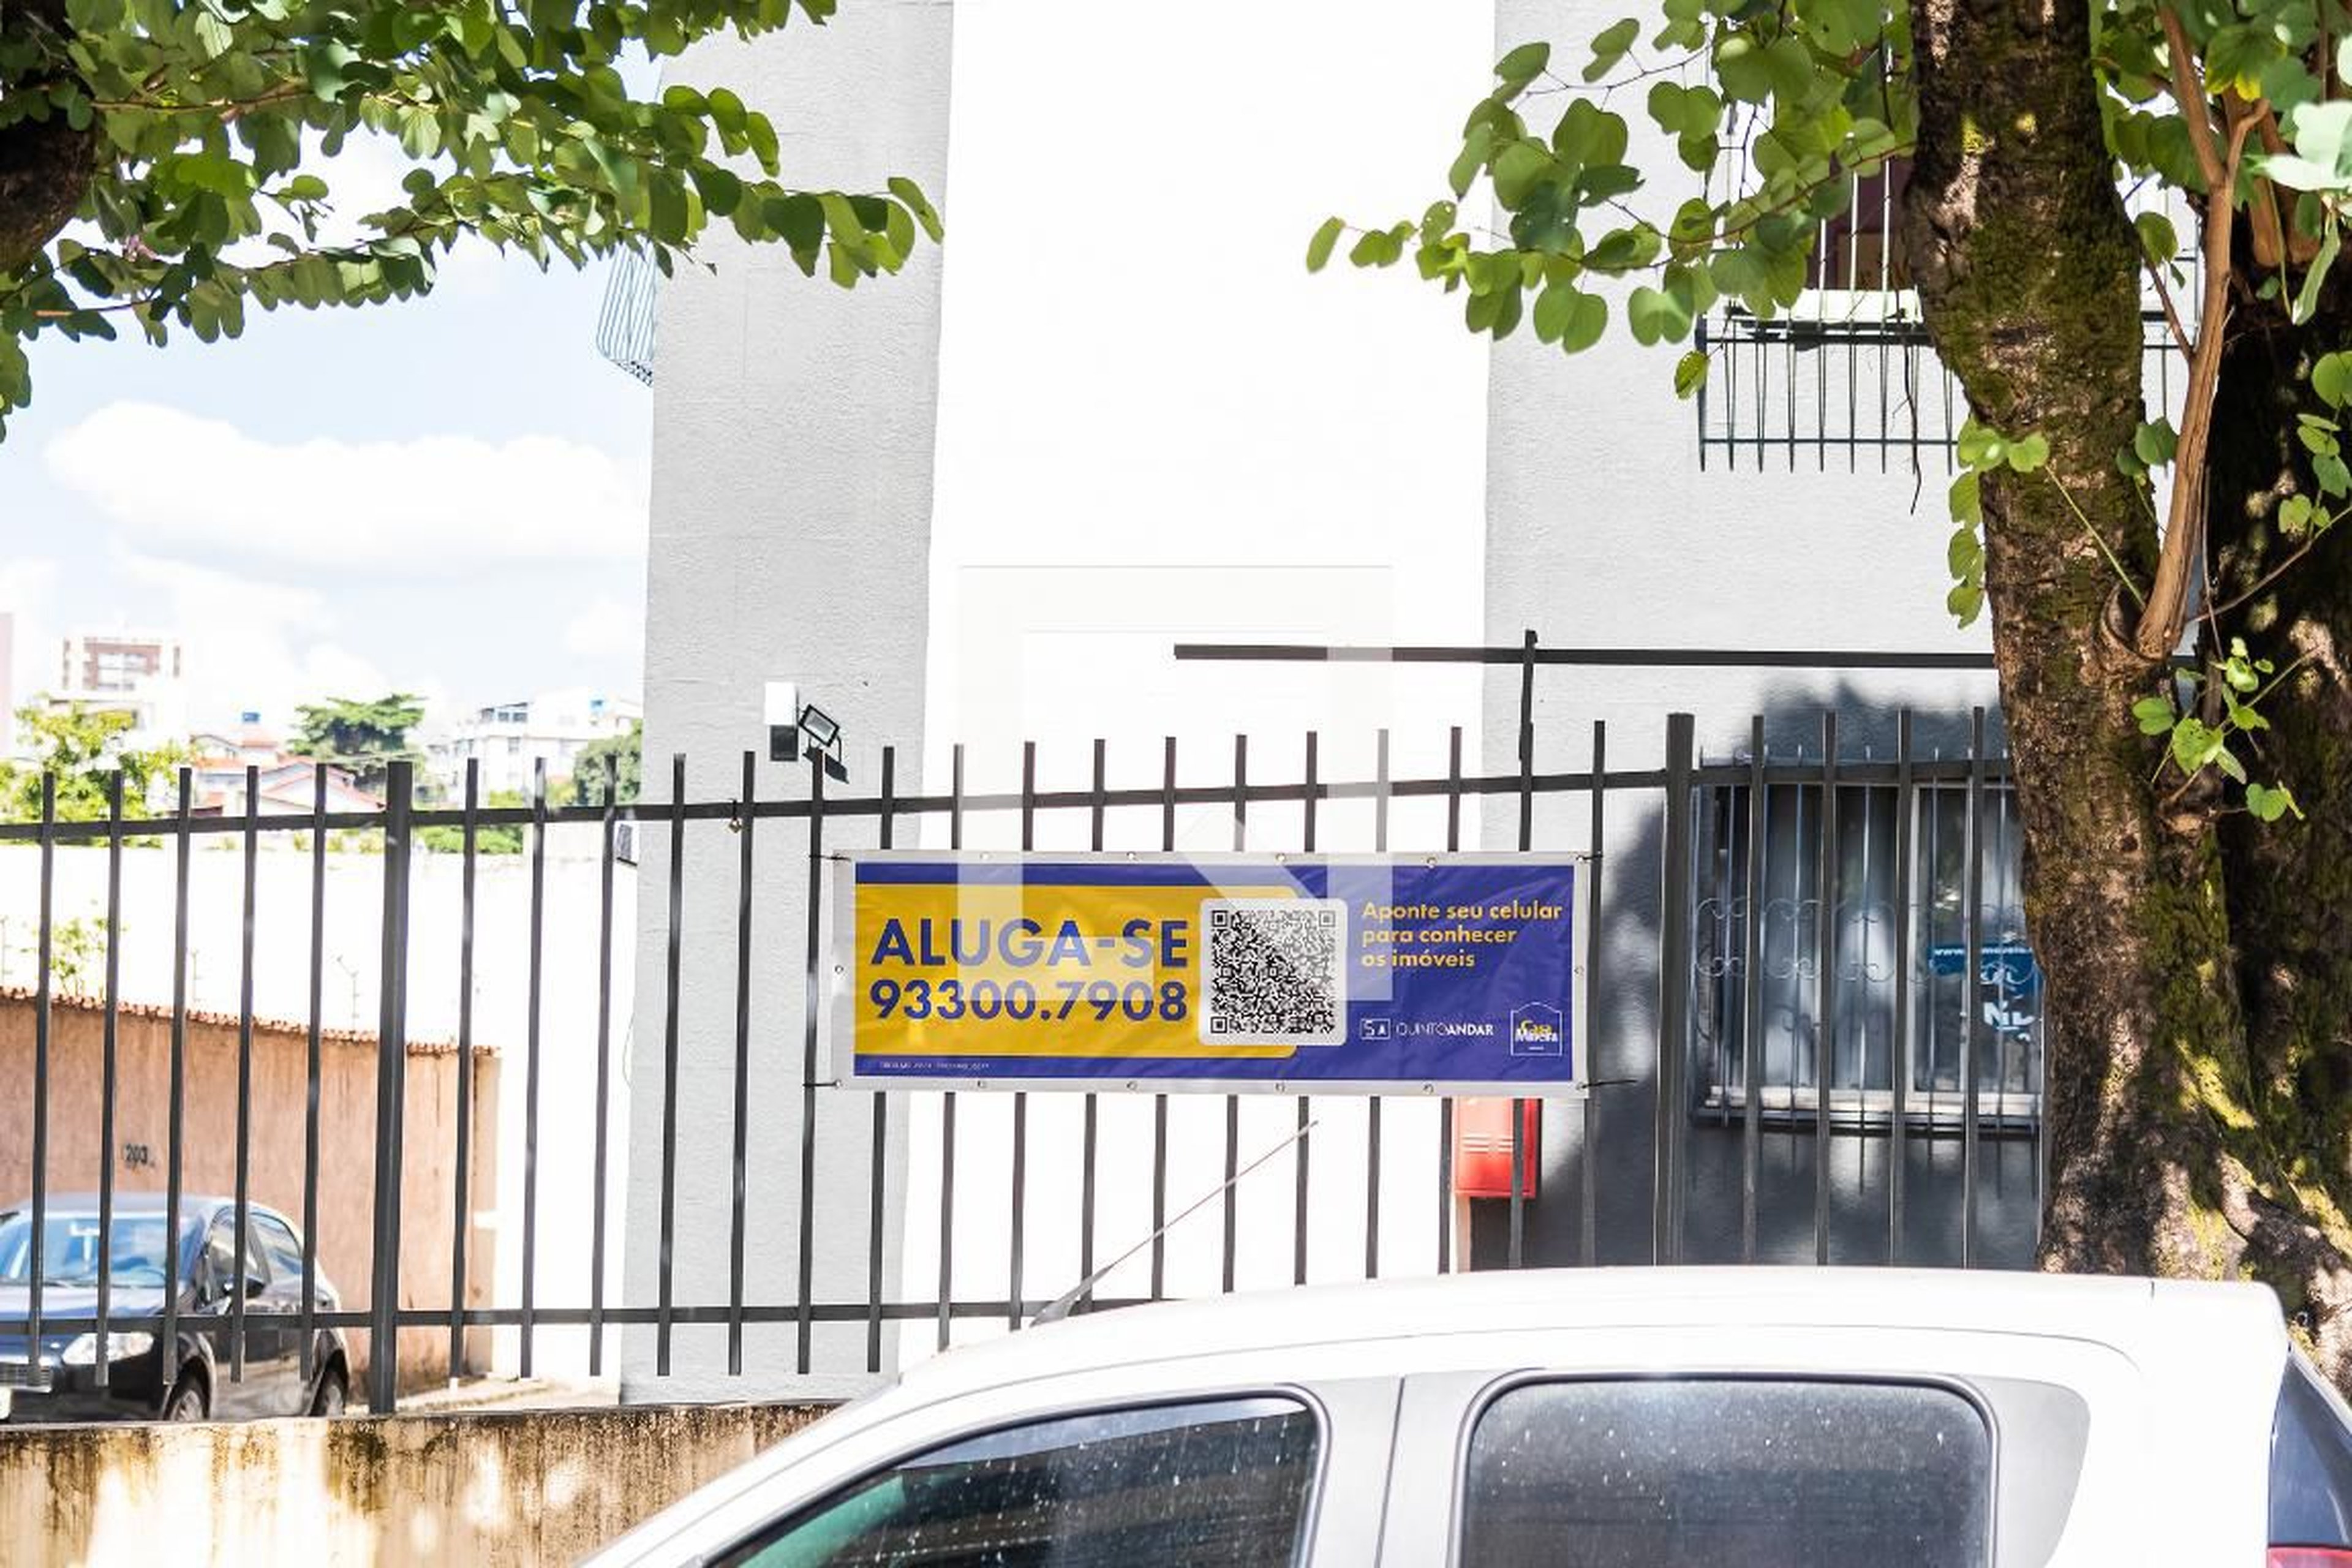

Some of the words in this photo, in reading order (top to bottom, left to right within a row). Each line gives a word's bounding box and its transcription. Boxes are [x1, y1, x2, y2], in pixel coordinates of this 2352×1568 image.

[1363, 902, 1441, 924] Aponte
[1446, 906, 1483, 919] seu
[1489, 899, 1563, 919] celular
[871, 918, 1189, 968] ALUGA-SE
[1362, 930, 1414, 948] para
[1419, 924, 1518, 943] conhecer
[1362, 954, 1387, 967] os
[1392, 948, 1476, 967] imóveis
[869, 979, 1188, 1022] 93300.7908
